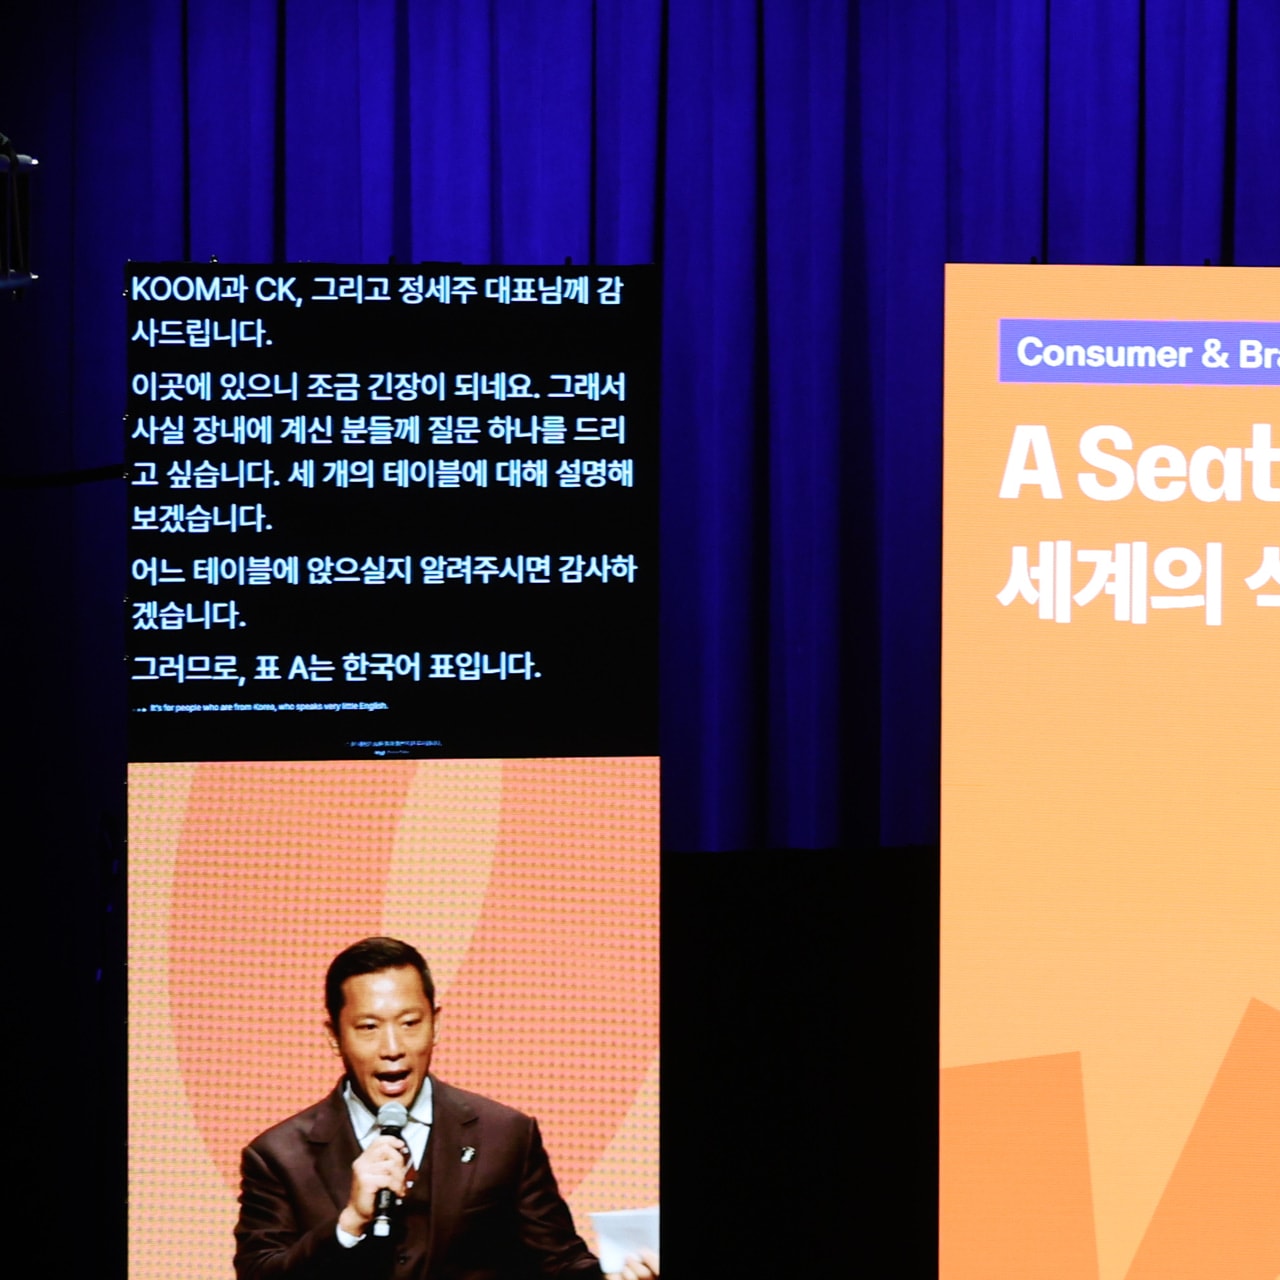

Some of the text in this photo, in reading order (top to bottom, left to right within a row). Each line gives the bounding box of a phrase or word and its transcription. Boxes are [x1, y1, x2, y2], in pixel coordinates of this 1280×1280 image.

[132, 274, 625, 308] KOOM과 CK, 그리고 정세주 대표님께 감
[131, 317, 273, 348] 사드립니다.
[1017, 335, 1194, 369] Consumer
[1201, 338, 1230, 369] &
[132, 371, 625, 402] 이곳에 있으니 조금 긴장이 되네요. 그래서
[131, 414, 625, 445] 사실 장내에 계신 분들께 질문 하나를 드리
[131, 458, 634, 489] 고 싶습니다. 세 개의 테이블에 대해 설명해
[999, 424, 1063, 500] A
[131, 503, 273, 533] 보겠습니다.
[131, 554, 639, 587] 어느 테이블에 앉으실지 알려주시면 감사하
[996, 540, 1223, 626] 세계의
[132, 600, 247, 631] 겠습니다.
[131, 651, 542, 687] 그러므로, 표 A는 한국어 표입니다.
